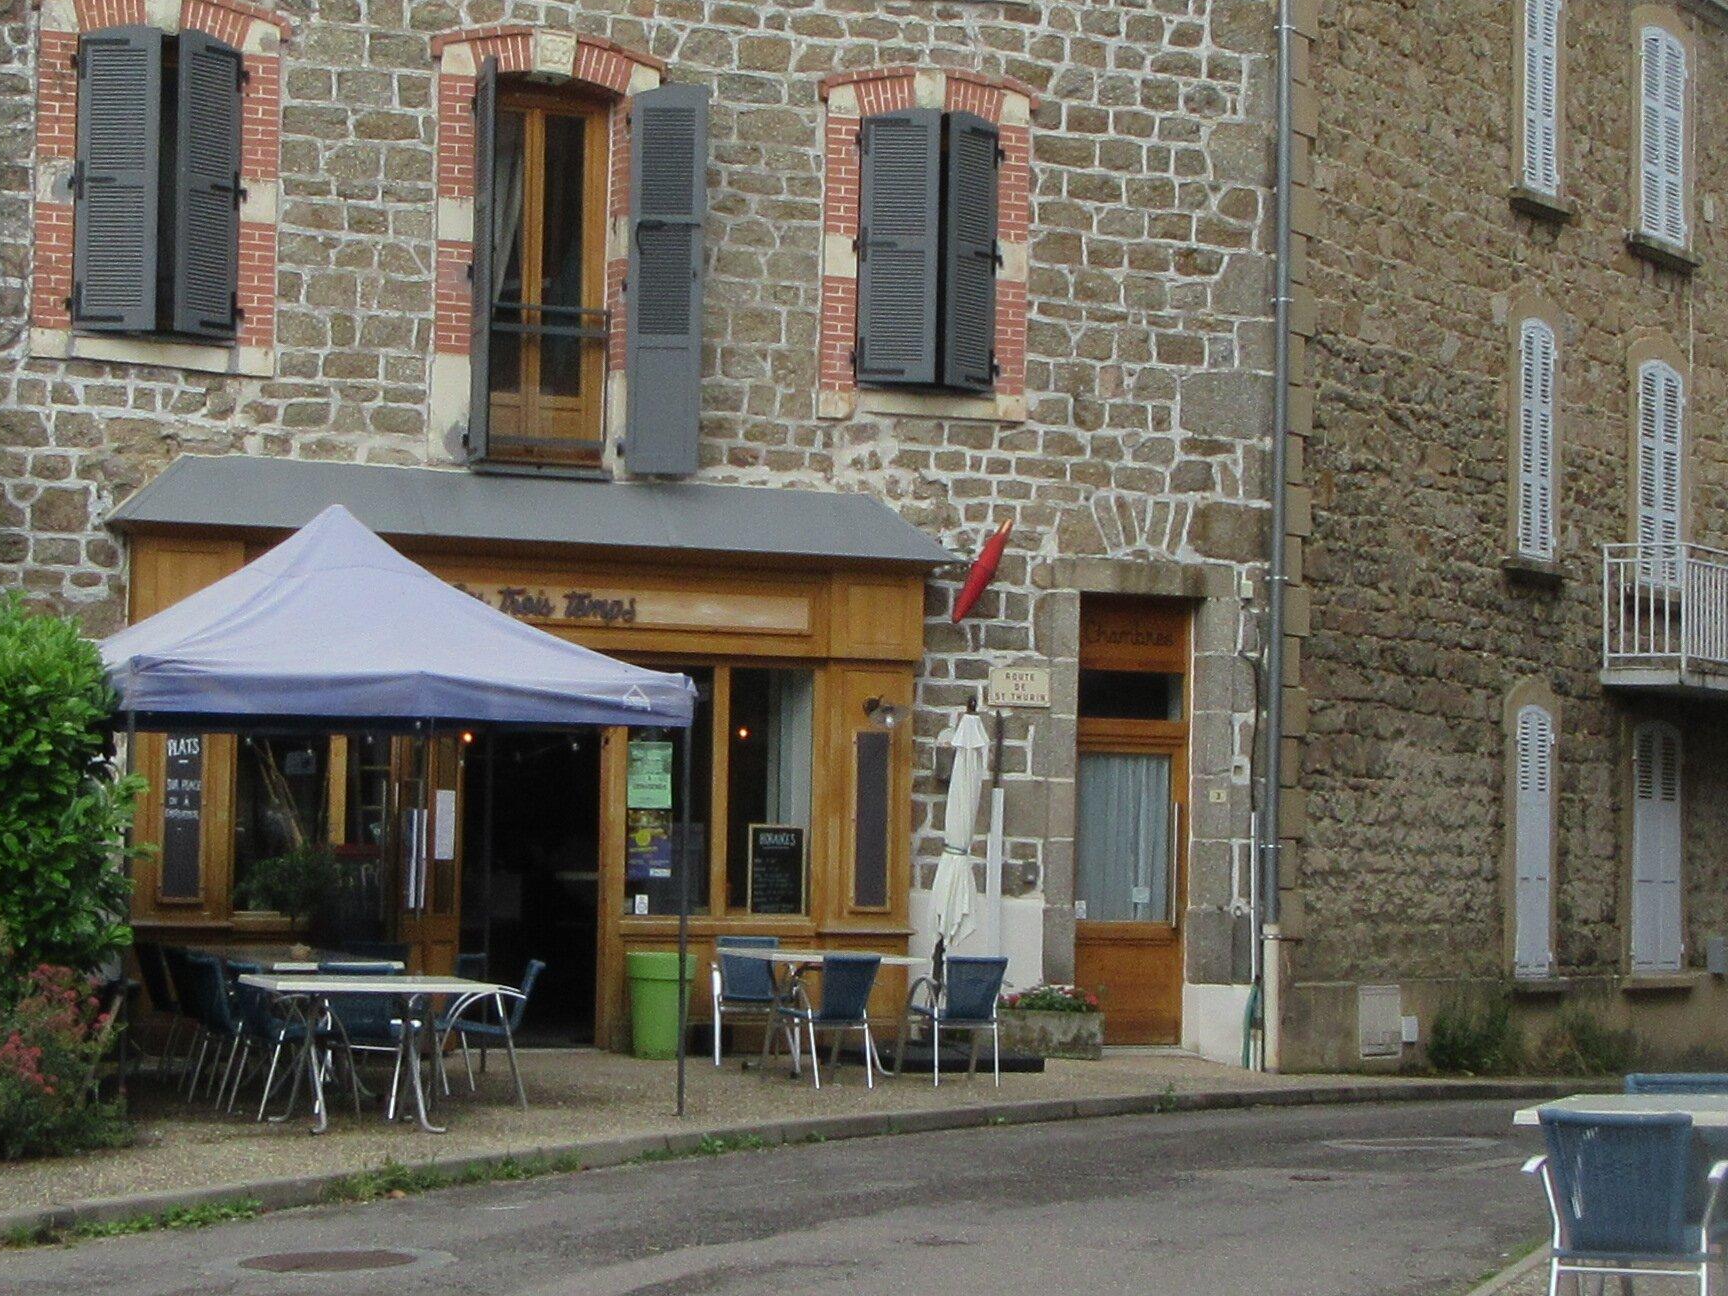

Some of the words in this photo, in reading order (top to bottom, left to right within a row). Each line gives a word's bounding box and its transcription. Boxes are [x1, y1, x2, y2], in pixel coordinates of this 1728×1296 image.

[1004, 671, 1036, 683] ROUTE
[1014, 682, 1027, 692] DE
[1011, 692, 1048, 703] THURIN
[167, 737, 201, 757] PLATS
